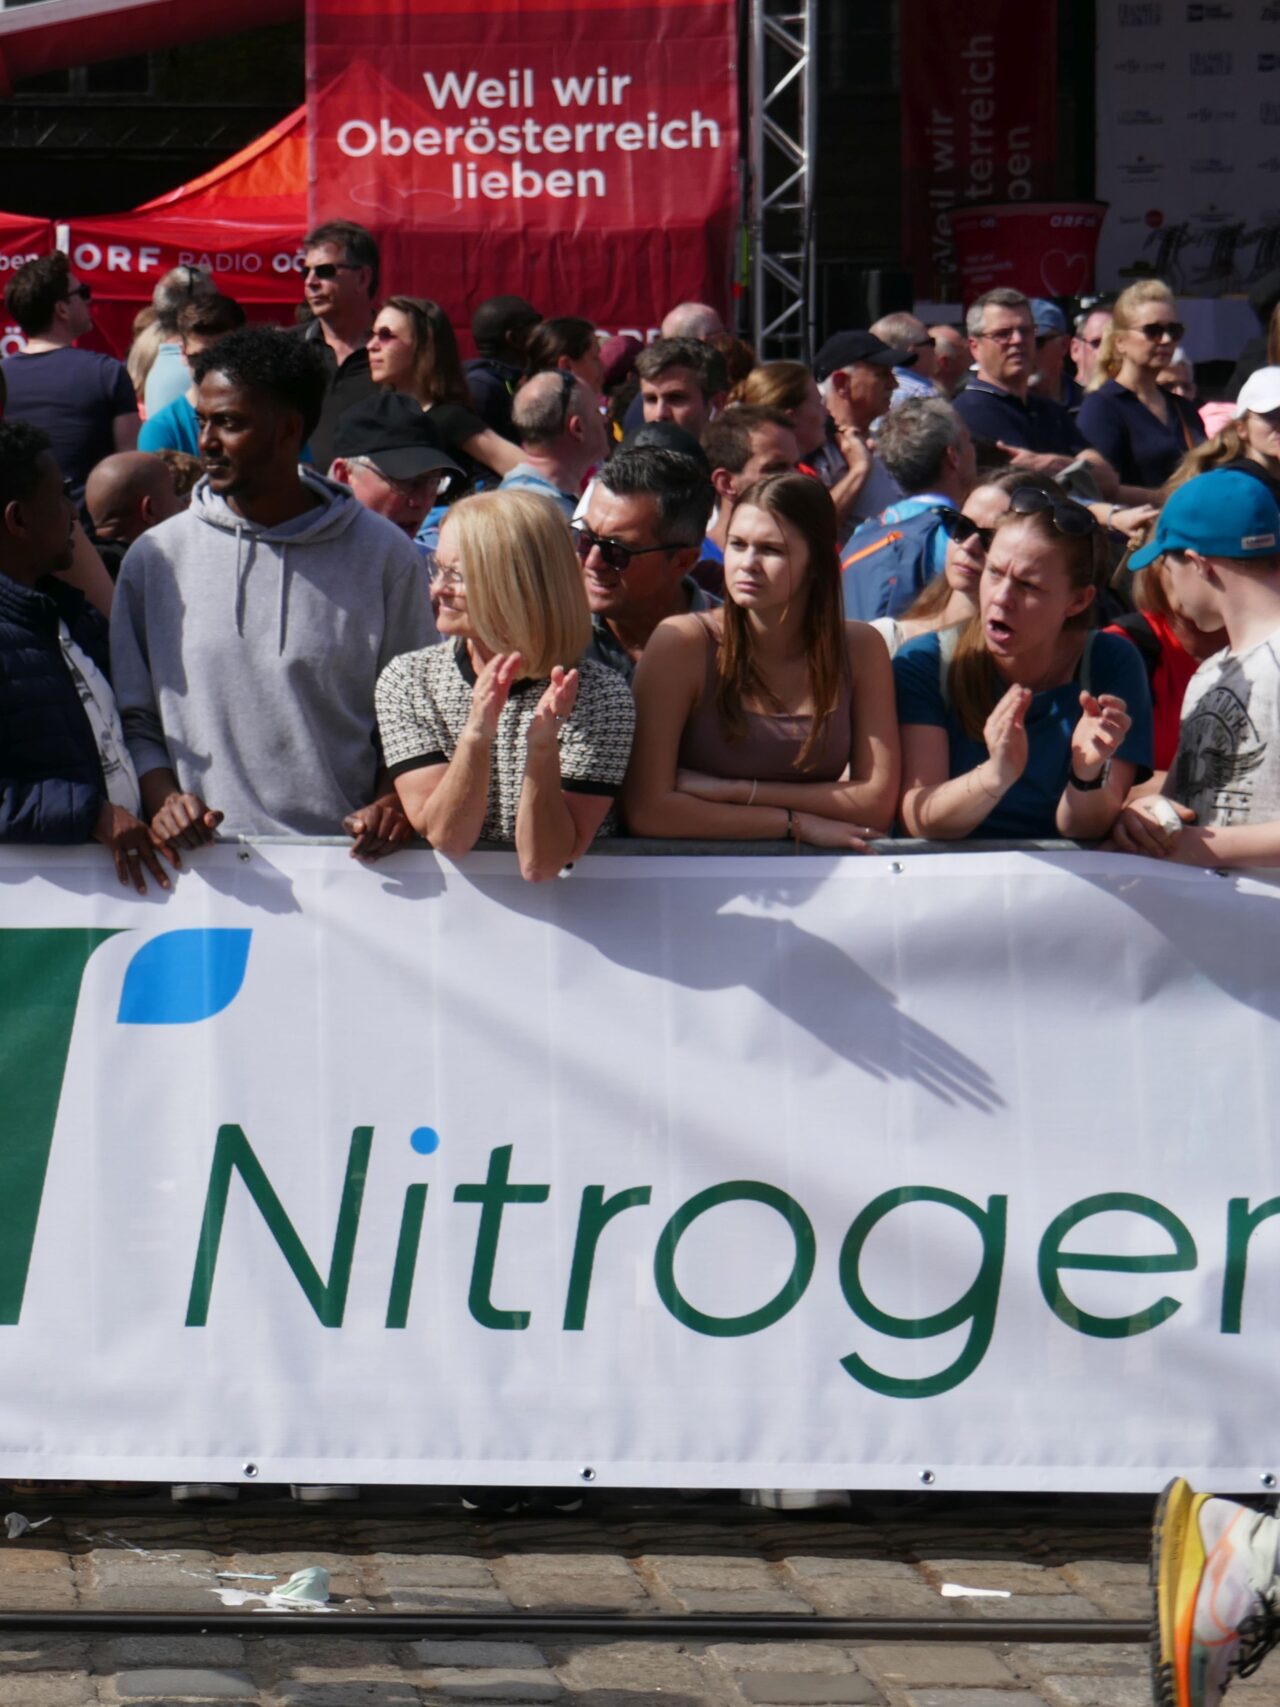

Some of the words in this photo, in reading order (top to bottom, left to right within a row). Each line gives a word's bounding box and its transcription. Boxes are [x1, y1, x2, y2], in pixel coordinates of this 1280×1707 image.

[423, 68, 534, 110] Weil
[552, 66, 632, 107] wir
[336, 110, 721, 158] Oberösterreich
[961, 34, 995, 199] terreich
[451, 161, 606, 200] lieben
[74, 243, 161, 273] ORF
[177, 251, 262, 272] RADIO
